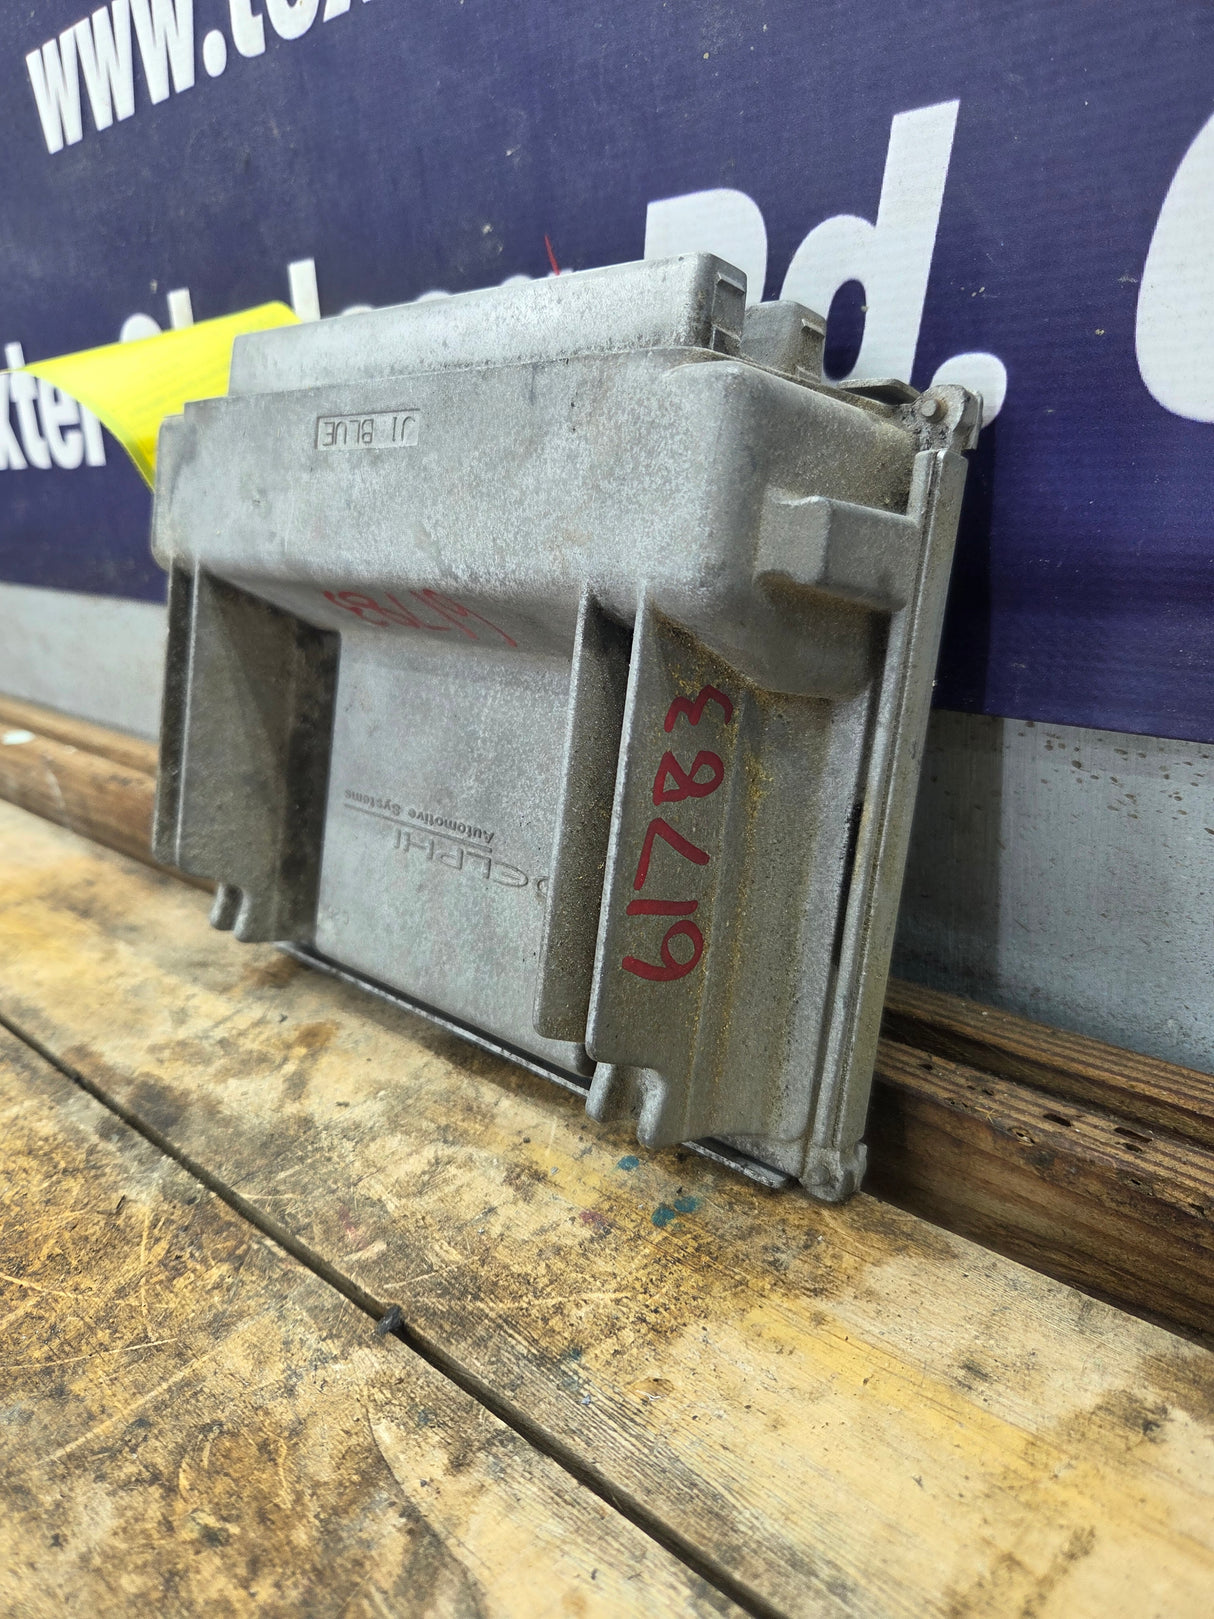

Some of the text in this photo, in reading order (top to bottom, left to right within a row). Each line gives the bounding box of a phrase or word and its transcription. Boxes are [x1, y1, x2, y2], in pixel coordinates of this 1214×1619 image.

[322, 417, 375, 447] BLUE
[344, 787, 495, 844] Automotive Systems
[622, 684, 734, 982] 61783
